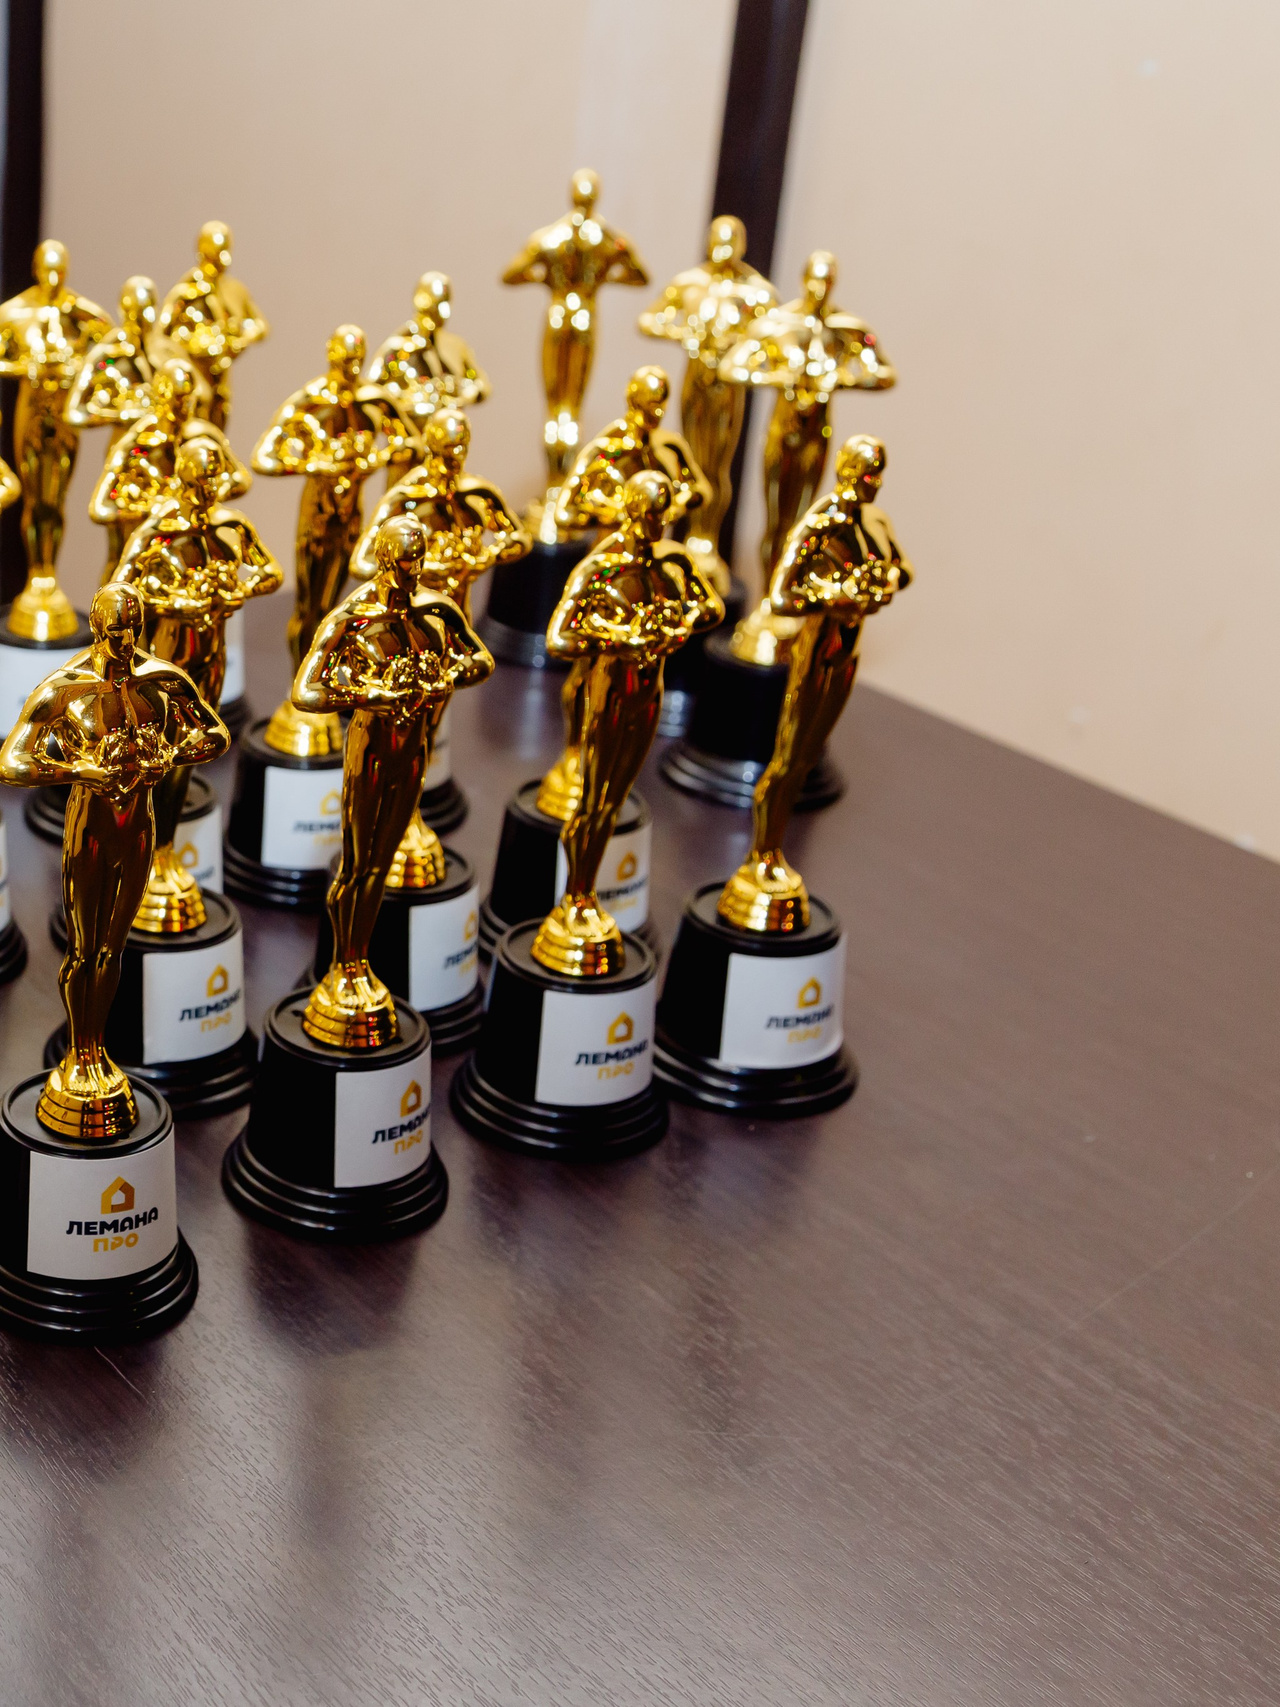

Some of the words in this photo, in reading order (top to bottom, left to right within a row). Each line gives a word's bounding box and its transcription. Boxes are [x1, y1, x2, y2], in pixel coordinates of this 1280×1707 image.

[597, 1060, 635, 1080] ПРО
[394, 1130, 423, 1155] ПРО
[66, 1207, 158, 1236] ЛЕМАНА
[93, 1232, 140, 1253] ПРО
